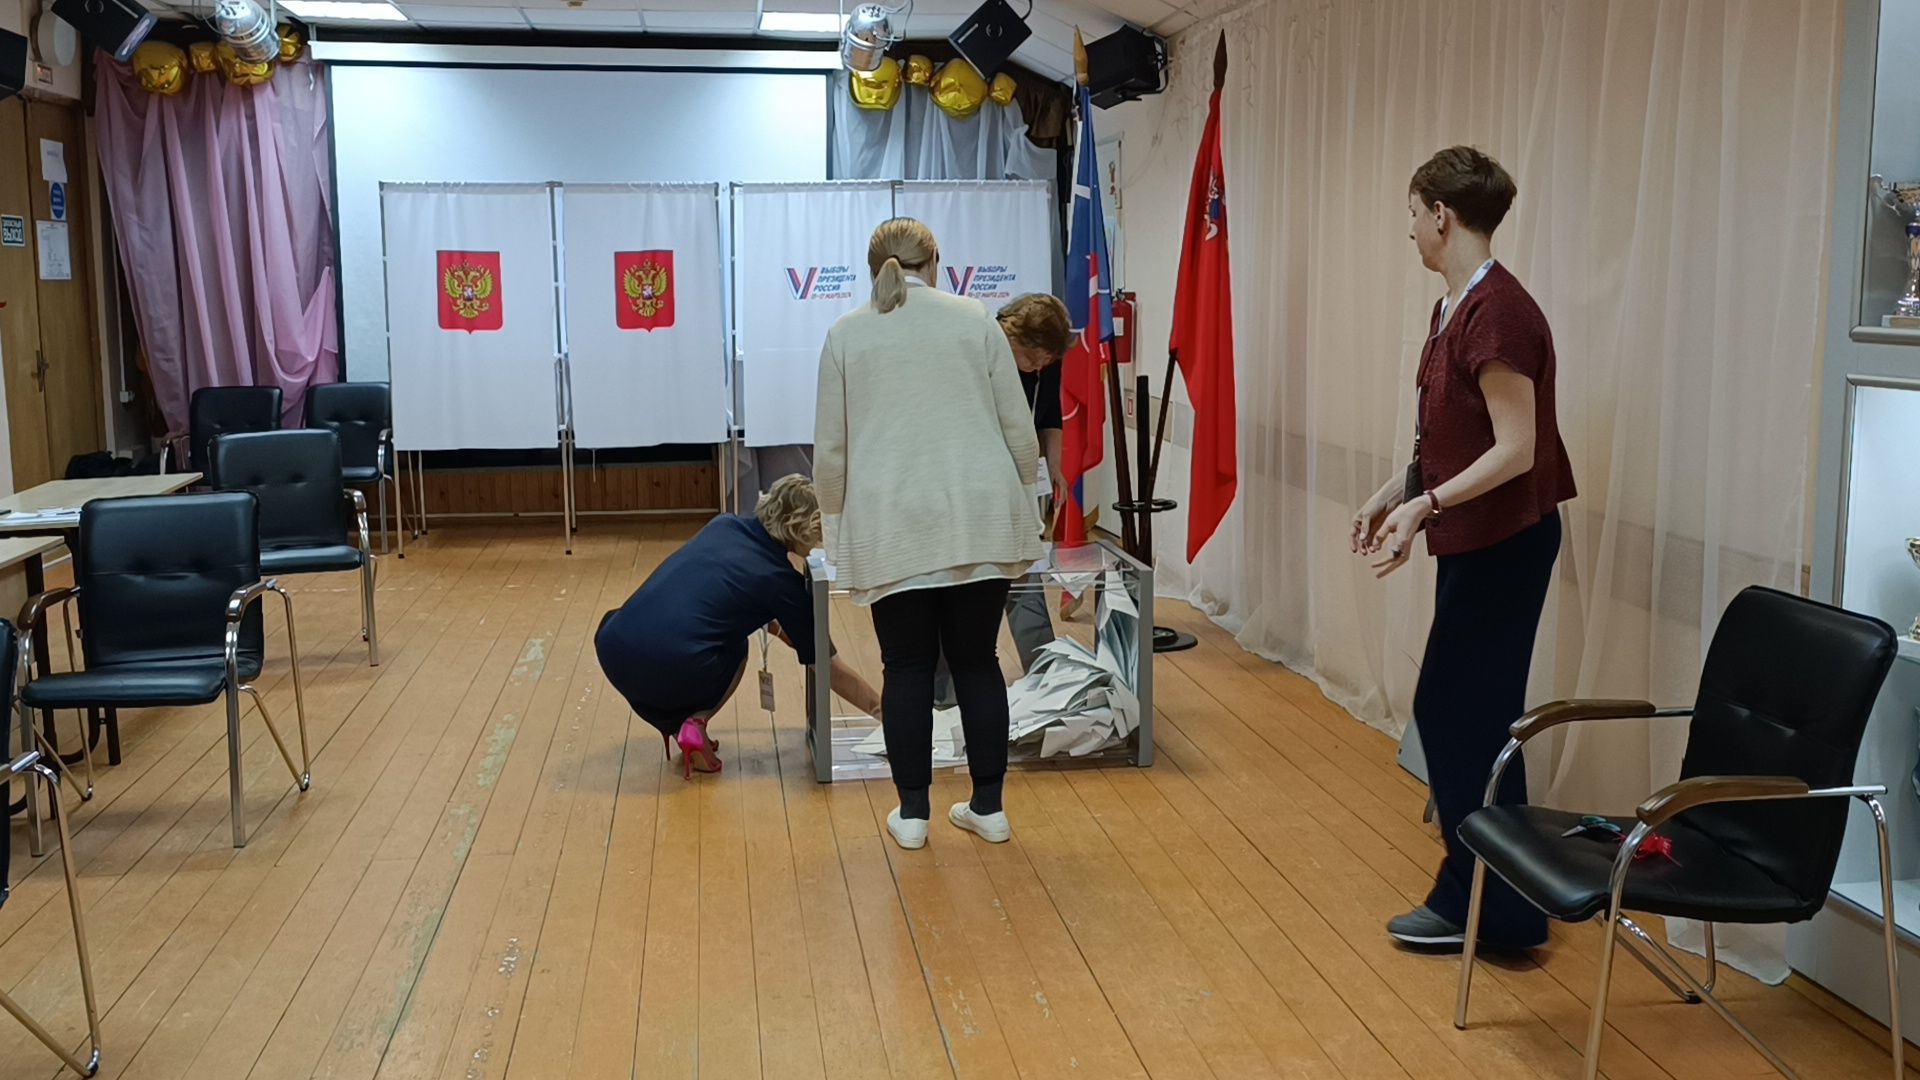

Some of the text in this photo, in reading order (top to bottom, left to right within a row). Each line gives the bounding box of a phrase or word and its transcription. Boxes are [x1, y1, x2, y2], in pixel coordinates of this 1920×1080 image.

[821, 266, 849, 274] ВЫБОРЫ
[977, 265, 1008, 273] ВЫБОРЫ
[817, 275, 857, 283] ПРЕЗИДЕНТА
[973, 273, 1016, 282] ПРЕЗИДЕНТА
[813, 284, 841, 292] РОССИИ
[969, 283, 998, 291] РОССИИ
